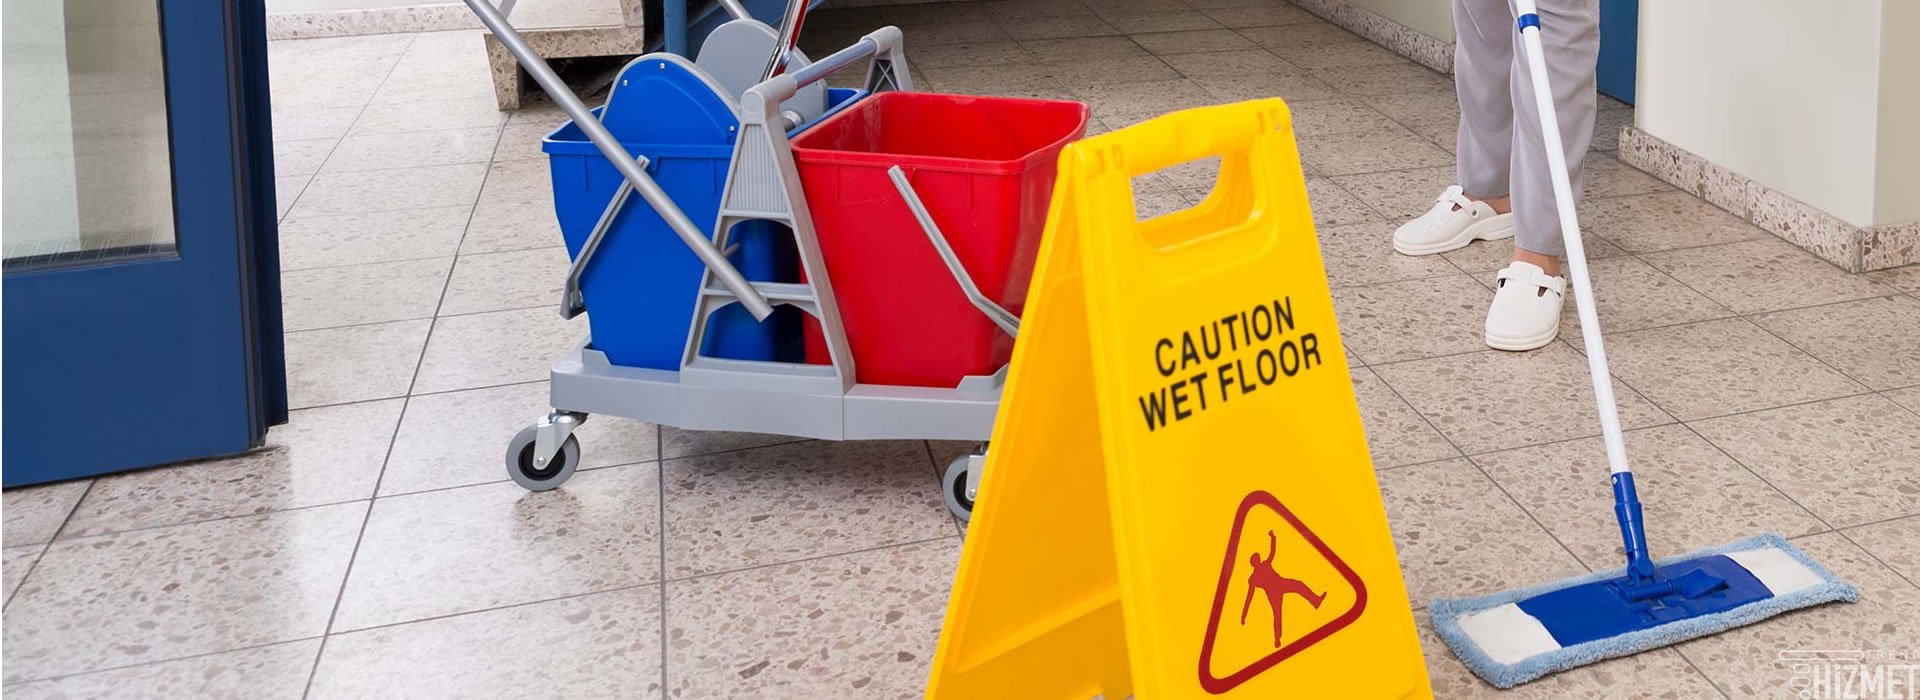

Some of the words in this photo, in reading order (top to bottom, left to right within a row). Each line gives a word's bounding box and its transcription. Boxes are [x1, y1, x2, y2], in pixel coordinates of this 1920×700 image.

[1155, 296, 1295, 377] CAUTION
[1138, 372, 1208, 432] WET
[1217, 332, 1322, 402] FLOOR
